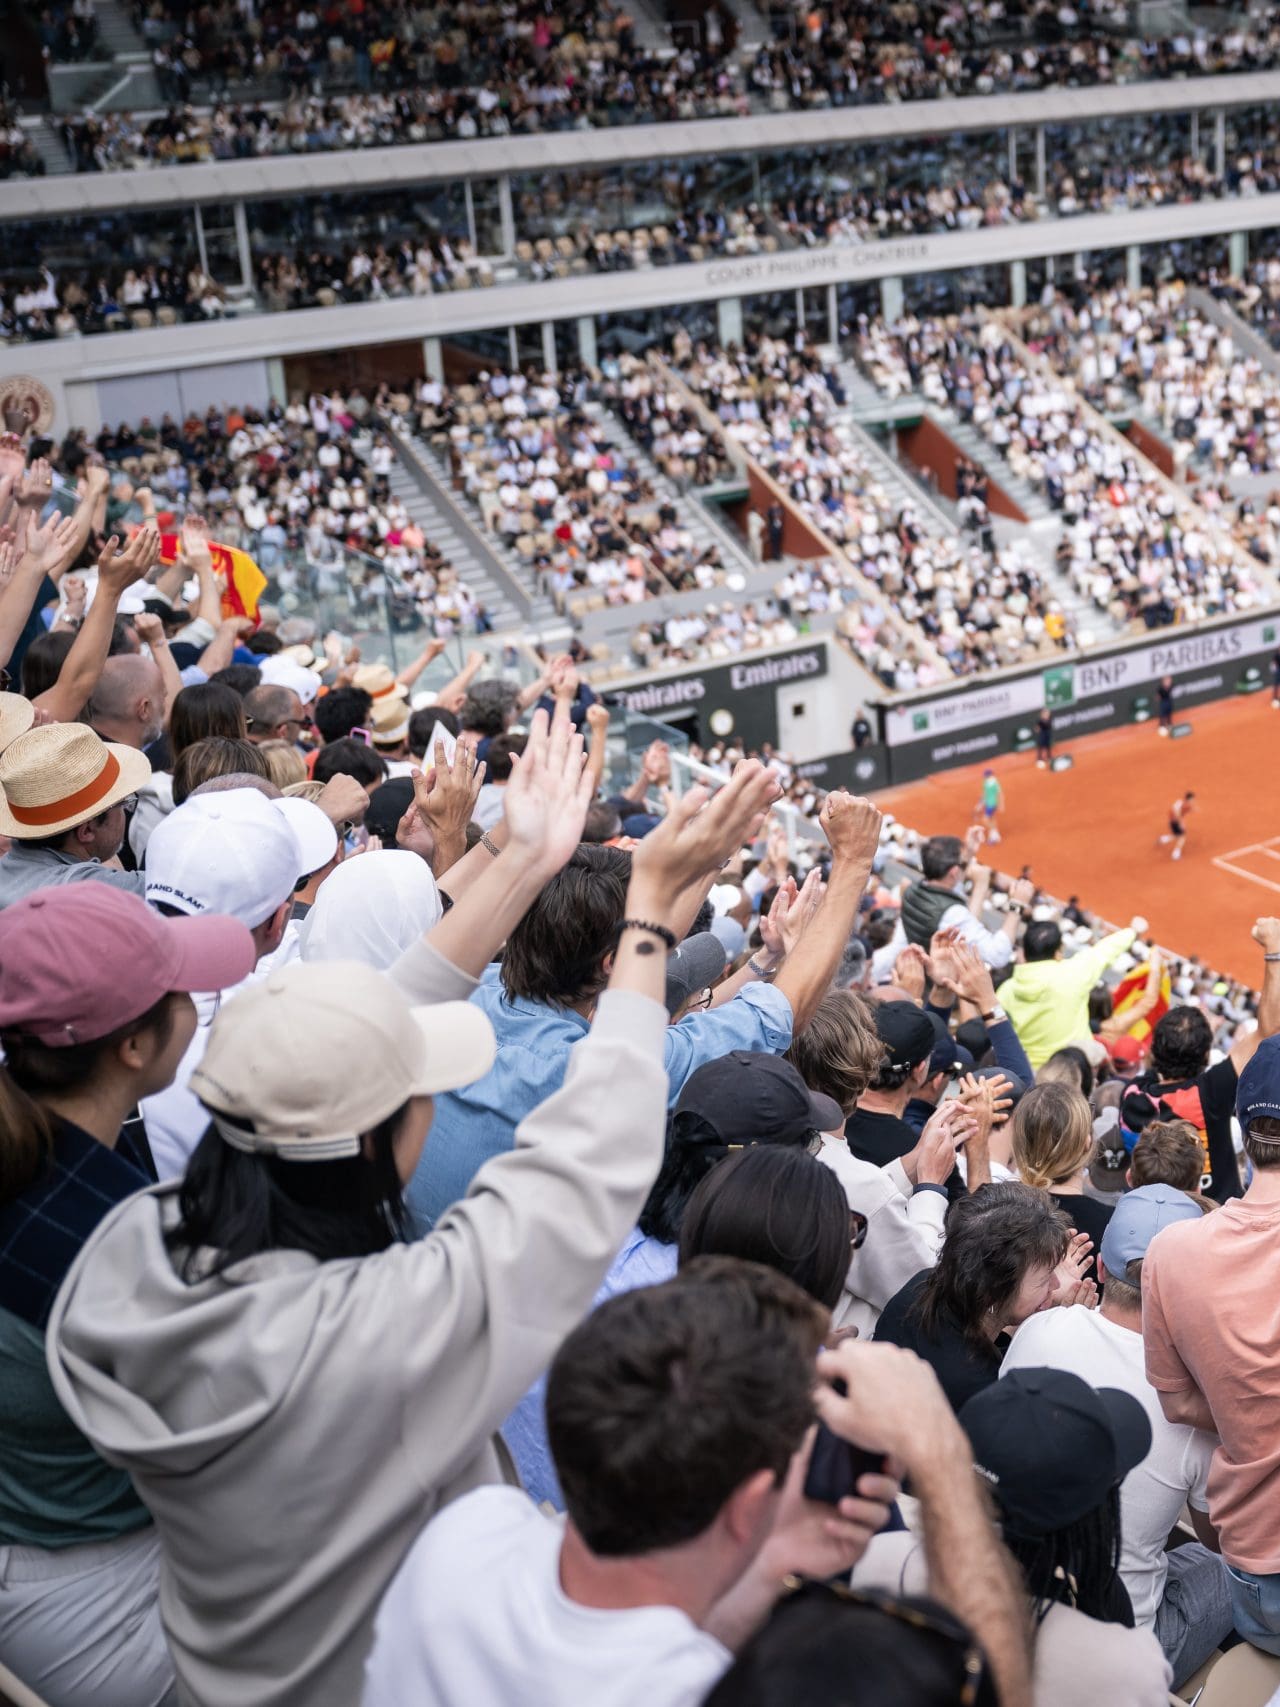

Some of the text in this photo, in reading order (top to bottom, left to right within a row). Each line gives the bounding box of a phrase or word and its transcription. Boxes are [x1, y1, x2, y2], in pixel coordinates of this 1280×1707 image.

[730, 651, 820, 690] Emirates
[1080, 631, 1242, 691] BNP PARIBAS
